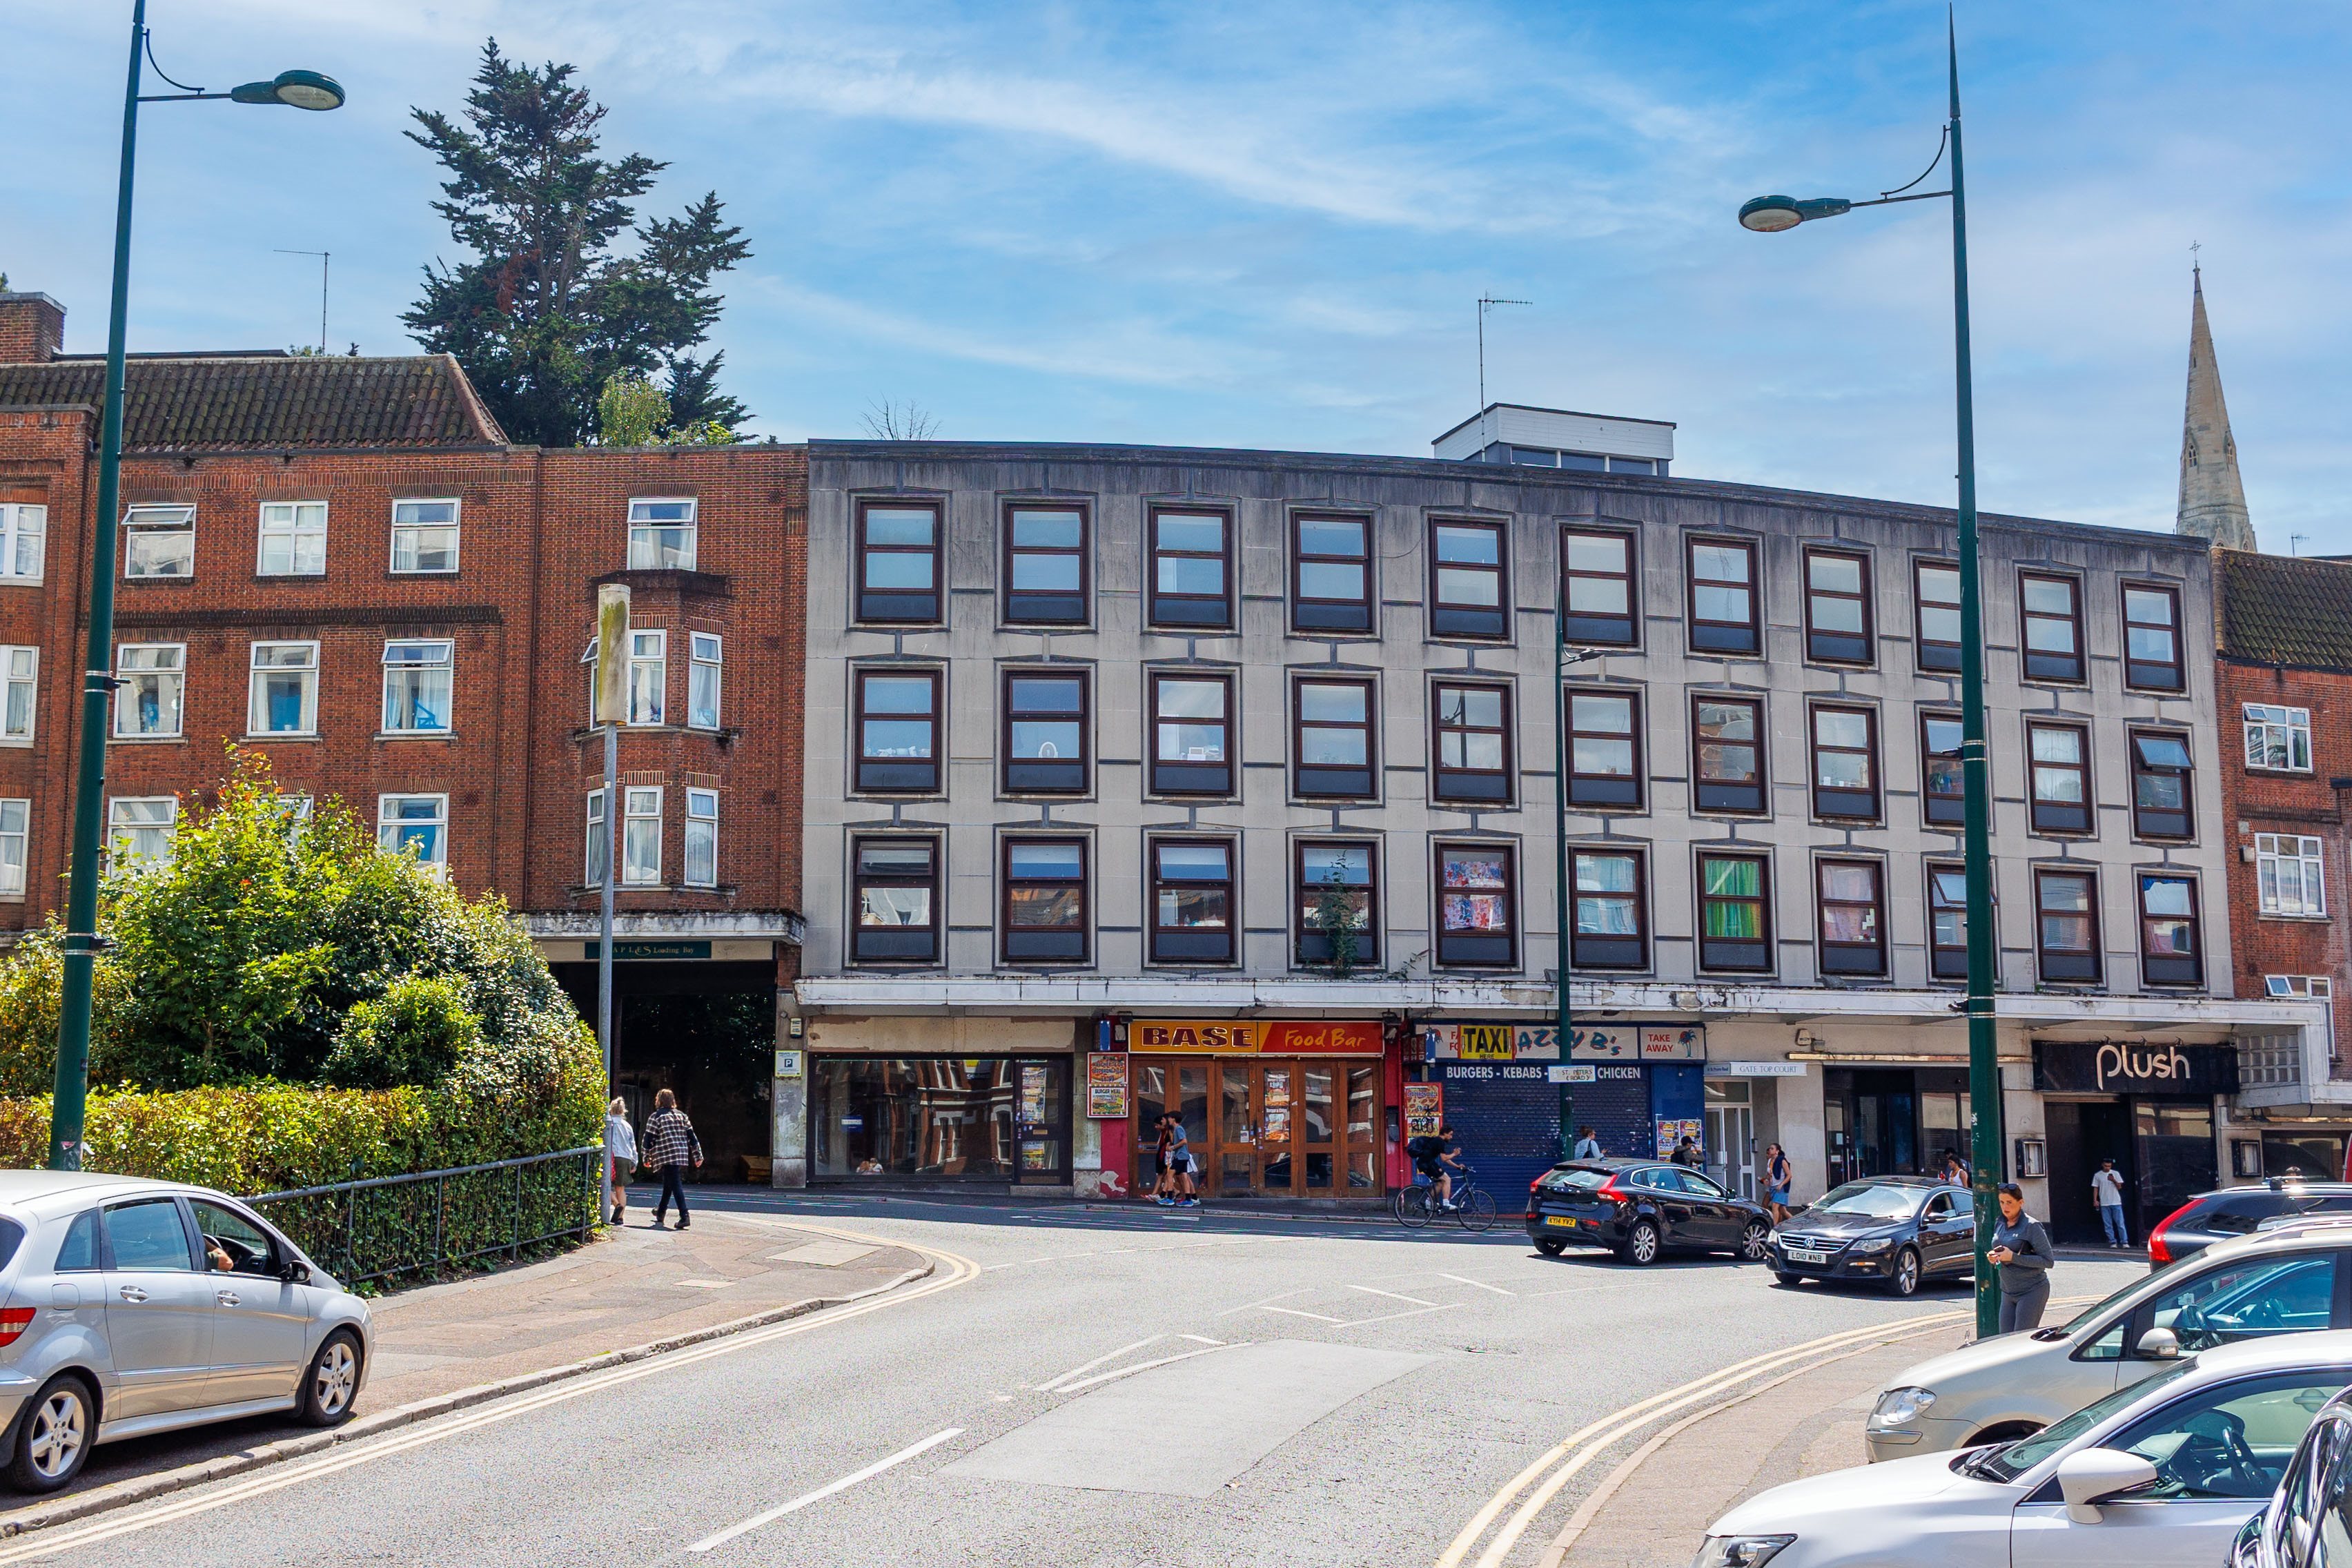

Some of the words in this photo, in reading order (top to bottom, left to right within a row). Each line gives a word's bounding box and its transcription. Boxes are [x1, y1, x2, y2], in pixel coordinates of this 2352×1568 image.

[612, 946, 651, 956] APLES
[1141, 1026, 1253, 1047] BASE
[1284, 1029, 1326, 1048] Food
[1331, 1028, 1366, 1048] Bar
[1463, 1028, 1508, 1053] TAXI
[1647, 1034, 1671, 1043] TAKE
[1646, 1044, 1674, 1052] AWAY
[1447, 1066, 1493, 1078] BURGERS
[1503, 1067, 1542, 1079] KEBABS
[1597, 1067, 1640, 1079] CHICKEN
